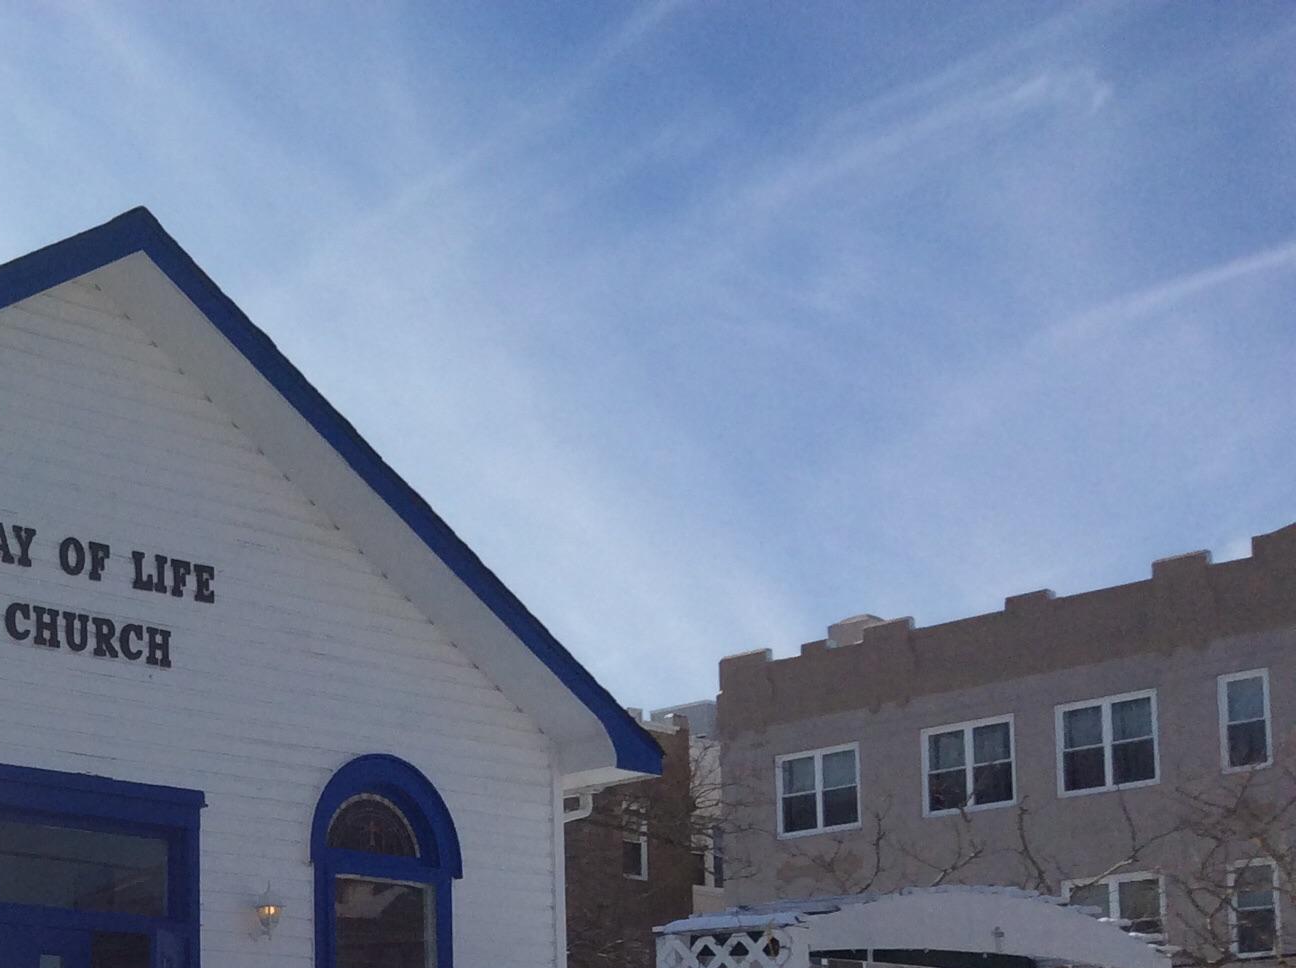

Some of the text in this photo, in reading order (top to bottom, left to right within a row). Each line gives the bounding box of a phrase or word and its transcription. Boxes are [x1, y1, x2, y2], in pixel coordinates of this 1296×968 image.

[59, 537, 110, 581] OF
[132, 551, 215, 604] LIFE
[5, 602, 171, 668] CHURCH
